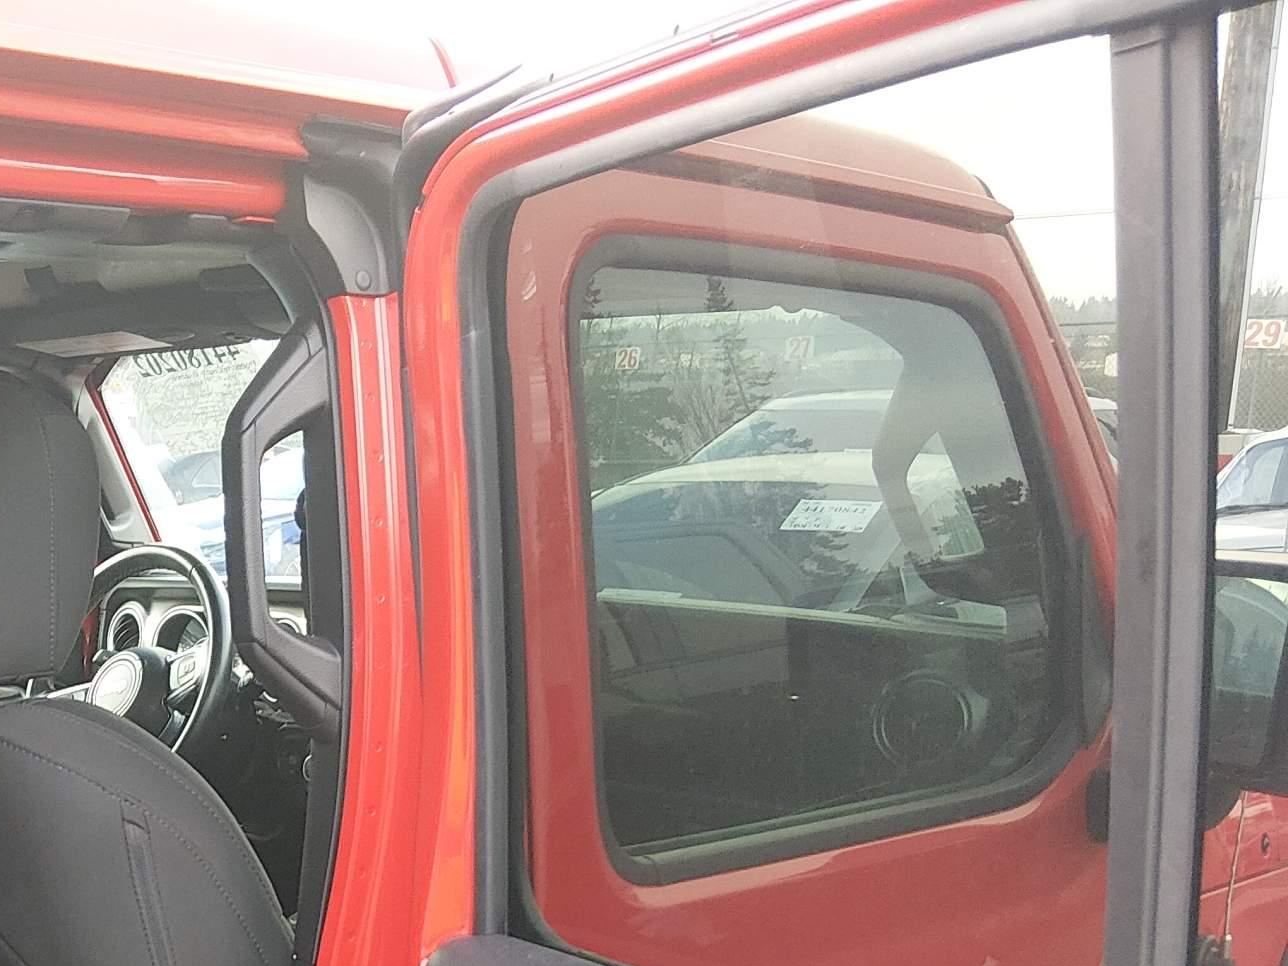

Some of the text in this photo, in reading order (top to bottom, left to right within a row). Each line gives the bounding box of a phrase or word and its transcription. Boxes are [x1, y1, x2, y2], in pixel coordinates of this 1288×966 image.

[1245, 320, 1281, 347] 29
[616, 349, 638, 369] 26
[789, 337, 811, 359] 27
